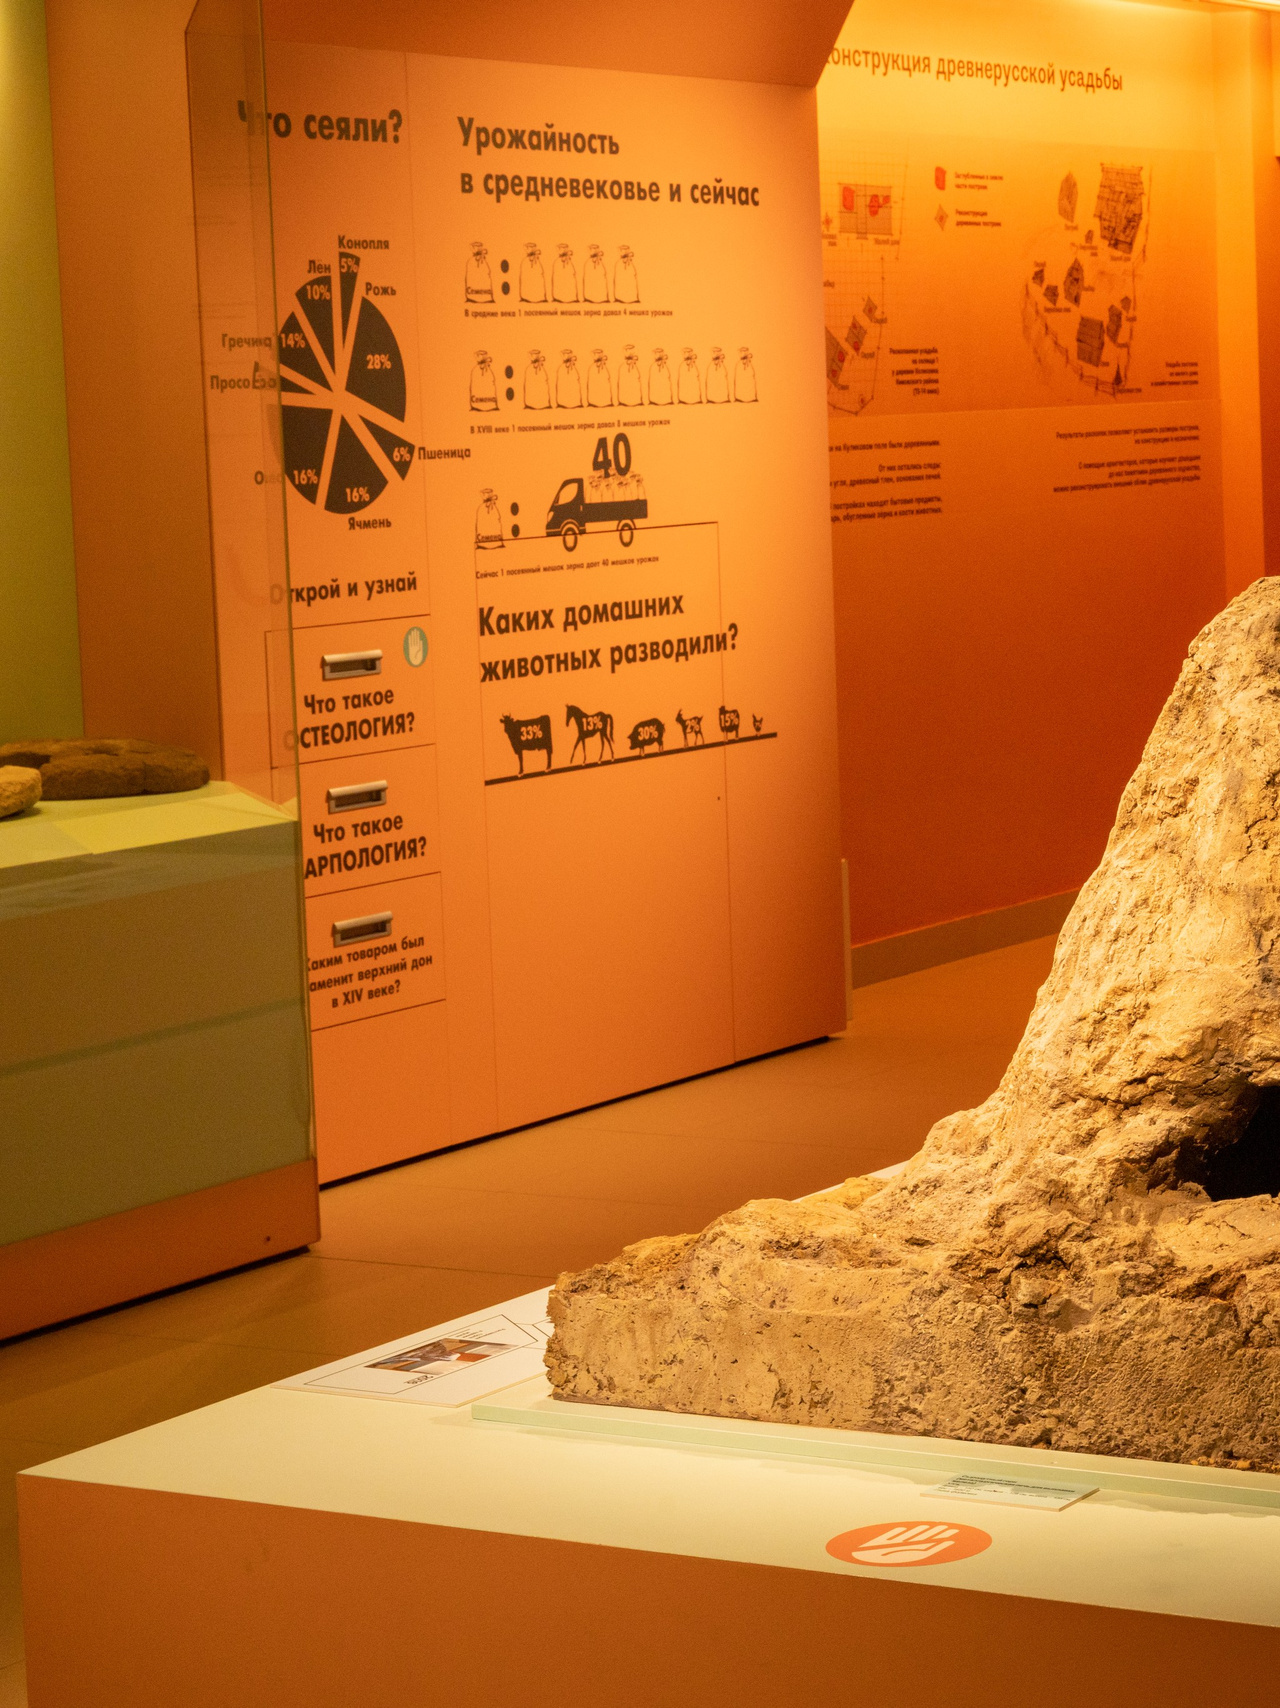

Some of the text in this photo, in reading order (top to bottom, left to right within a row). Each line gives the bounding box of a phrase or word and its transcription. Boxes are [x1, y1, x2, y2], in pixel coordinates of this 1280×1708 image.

[826, 47, 1123, 93] онструкция древнерусской усадьбы
[303, 109, 403, 144] сеяли?
[457, 116, 620, 156] Урожайность
[460, 172, 760, 206] в средневековье и сейчас
[338, 235, 390, 250] Конопля
[340, 257, 359, 274] 5%
[306, 285, 331, 300] 10%
[365, 282, 397, 297] Рожь
[465, 309, 470, 317] В
[471, 309, 499, 318] средние
[500, 310, 516, 318] века
[524, 308, 558, 317] посеянный
[560, 309, 581, 317] мешок
[583, 309, 601, 318] зерна
[603, 309, 621, 318] давал
[651, 310, 673, 318] урожая
[280, 333, 306, 348] 14%
[366, 354, 392, 370] 28%
[210, 375, 250, 392] Просо
[470, 425, 475, 434] В
[477, 425, 493, 434] XVIII
[495, 426, 510, 434] веке
[517, 423, 552, 432] посеянный
[577, 424, 595, 432] зерна
[597, 422, 615, 430] давал
[622, 420, 646, 428] мешков
[648, 419, 671, 428] урожая
[393, 448, 411, 461] 6%
[418, 446, 471, 461] Пшеница
[592, 432, 632, 478] 40
[293, 470, 318, 484] 16%
[345, 487, 370, 502] 16%
[348, 517, 392, 530] Ячмень
[475, 570, 499, 579] Сейчас
[506, 564, 541, 577] посеянный
[543, 562, 564, 573] мешок
[566, 562, 584, 572] зерна
[602, 558, 609, 568] 40
[611, 558, 635, 567] мешков
[636, 556, 659, 565] урожая
[347, 582, 358, 597] и
[365, 571, 417, 600] узнай
[479, 595, 684, 636] Каких домашних
[480, 622, 739, 683] животных разводили?
[304, 689, 394, 715] Что такое
[582, 716, 603, 731] 13%
[685, 719, 700, 732] 2%
[720, 713, 739, 727] 15%
[520, 725, 543, 740] 33%
[638, 726, 659, 741] 30%
[313, 815, 404, 844] Что такое
[304, 836, 427, 880] АРПОЛОГИЯ?
[347, 944, 397, 963] товаром
[401, 936, 424, 950] был
[309, 955, 433, 992] аменит верхний дон
[331, 979, 401, 1008] в XIV веке?
